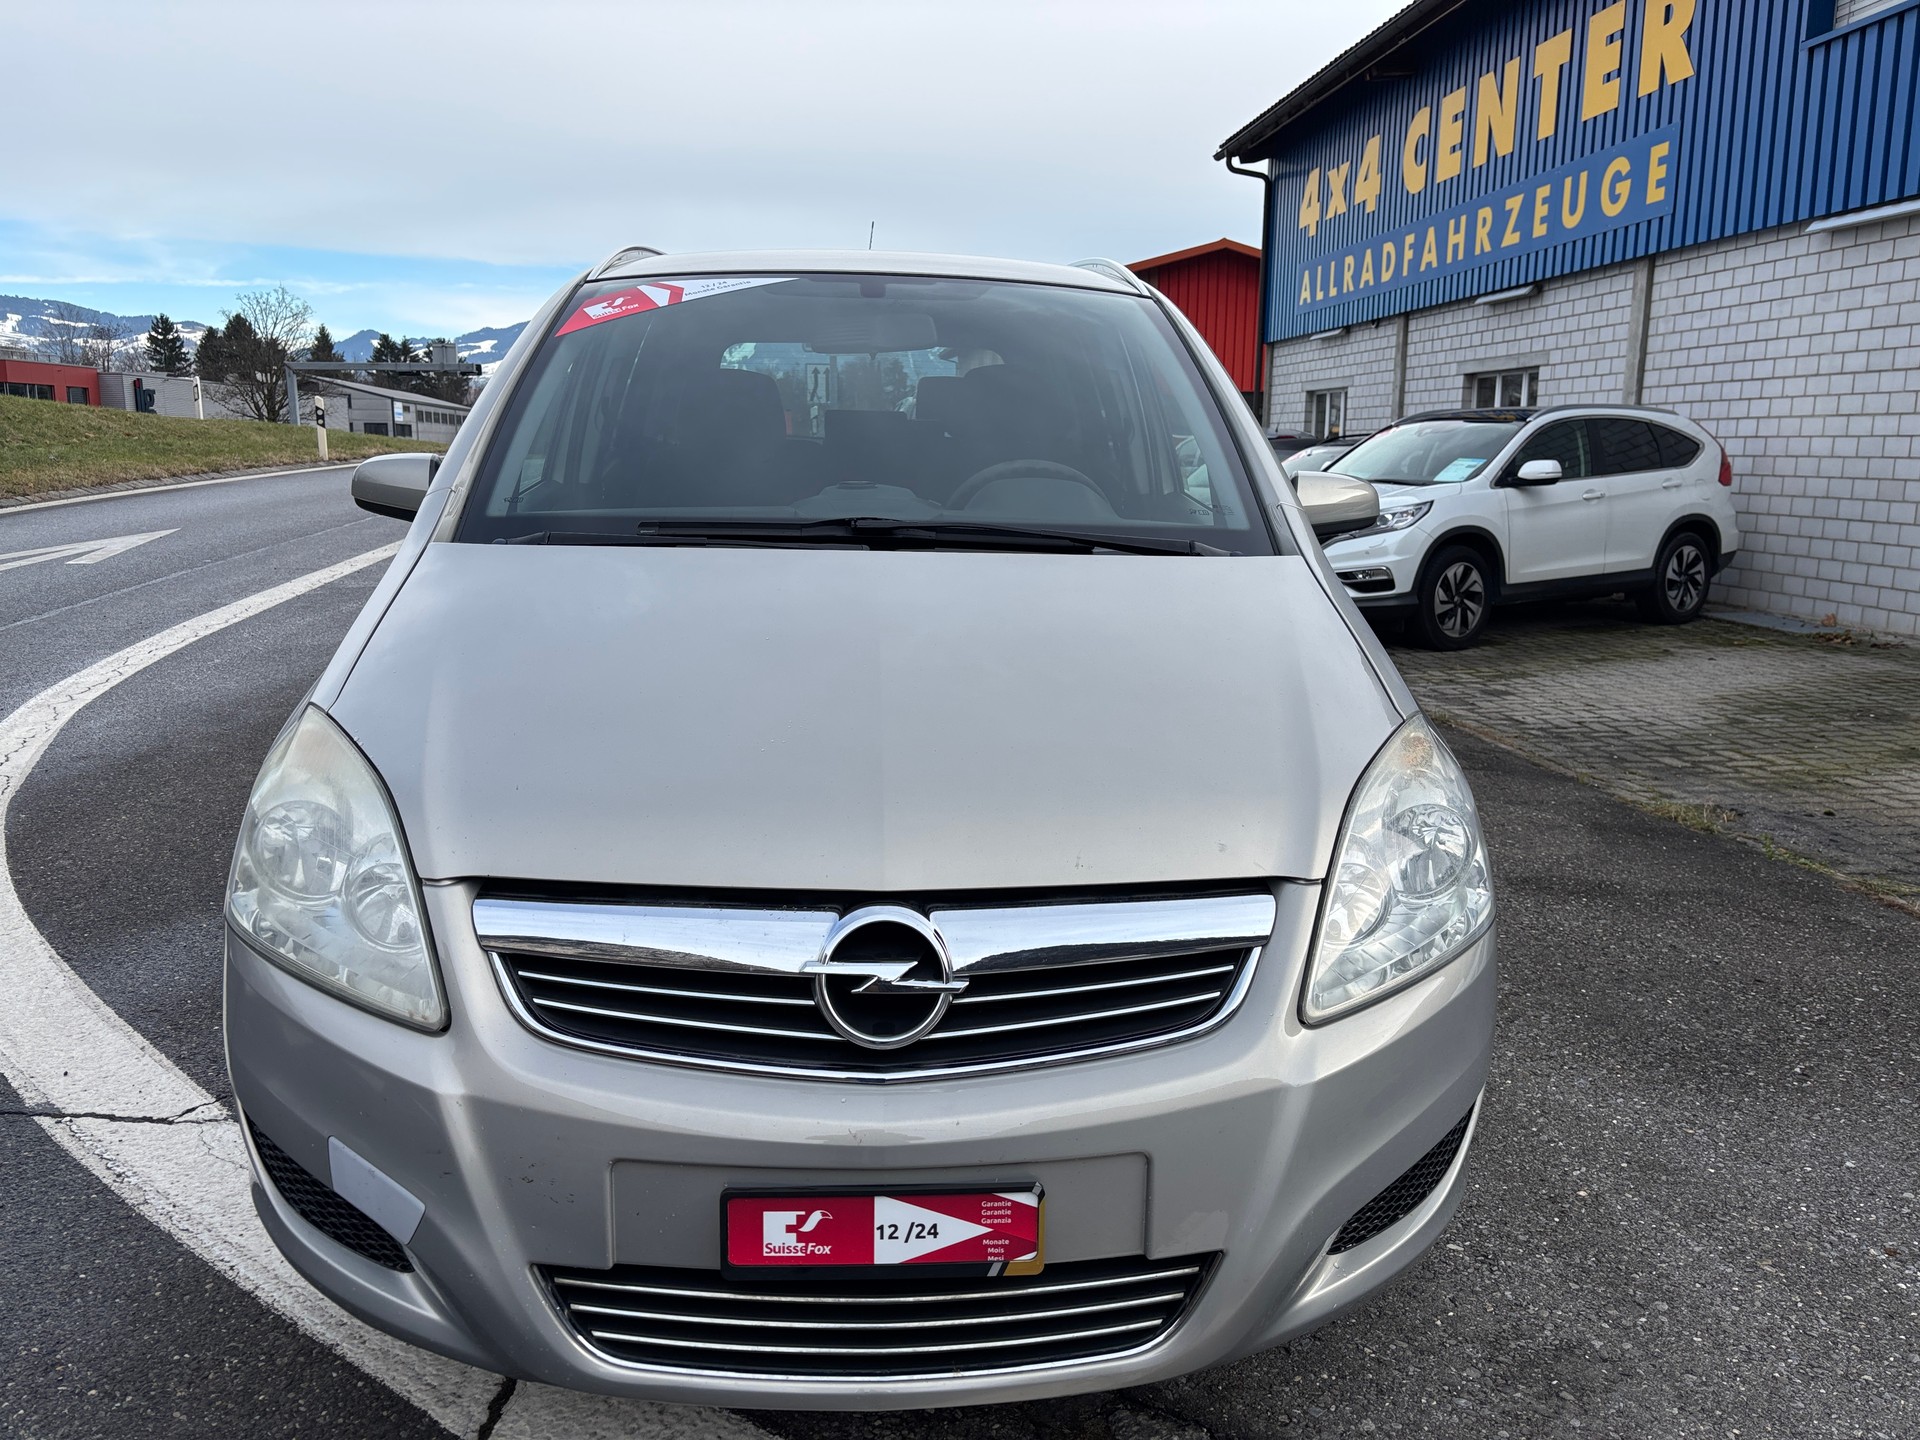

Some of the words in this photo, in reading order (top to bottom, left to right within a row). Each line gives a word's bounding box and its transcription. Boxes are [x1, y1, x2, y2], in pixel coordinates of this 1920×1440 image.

[1403, 0, 1696, 195] CENTER
[1299, 141, 1670, 306] ALLRADFAHRZEUGE
[684, 287, 715, 297] Monate
[717, 280, 751, 290] Garantie
[981, 1200, 1012, 1208] Garantie
[876, 1223, 899, 1240] 12
